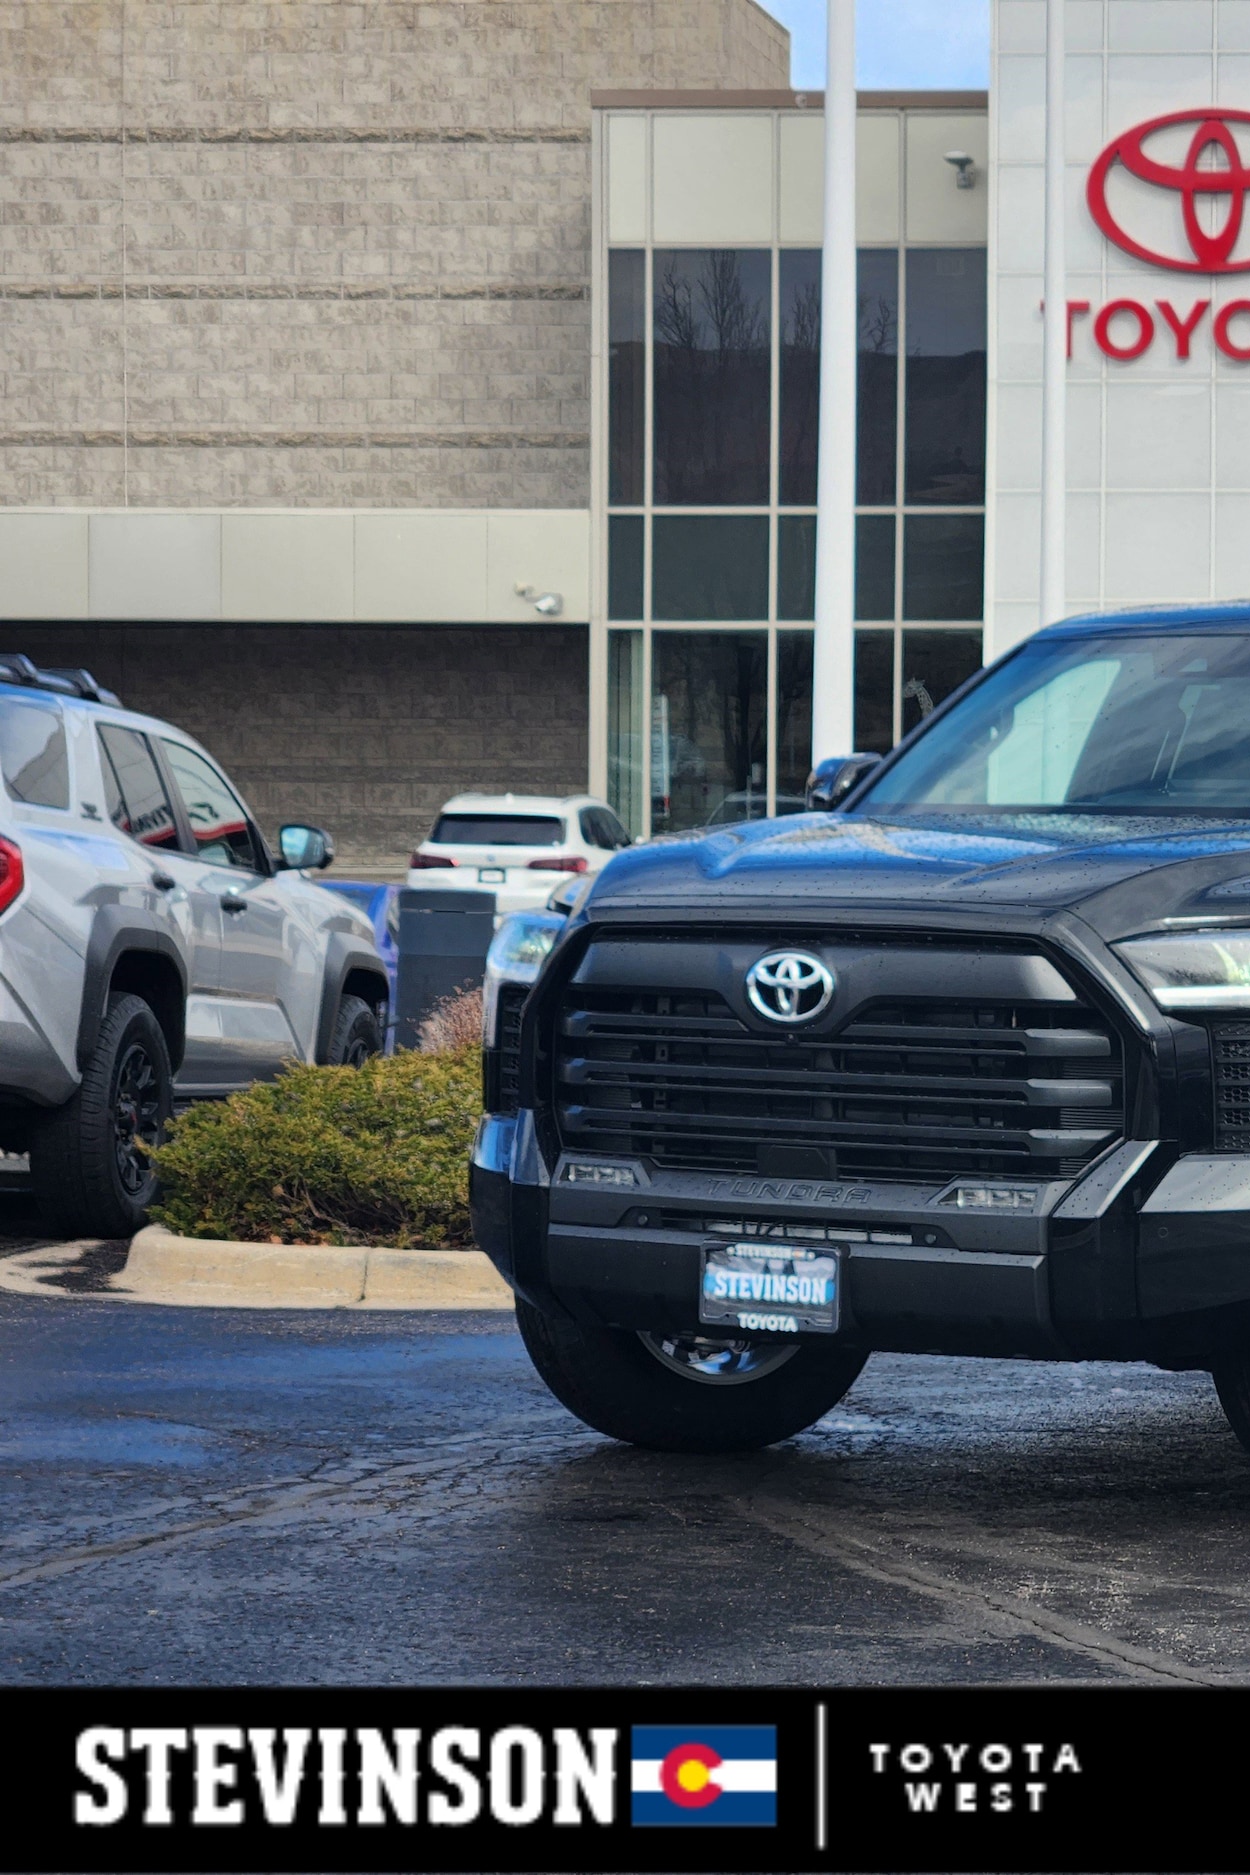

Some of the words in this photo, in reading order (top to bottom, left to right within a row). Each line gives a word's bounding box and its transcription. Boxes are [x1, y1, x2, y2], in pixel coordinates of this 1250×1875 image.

[708, 1178, 872, 1204] TUNDRA
[713, 1270, 828, 1305] STEVINSON
[737, 1312, 799, 1332] TOYOTA
